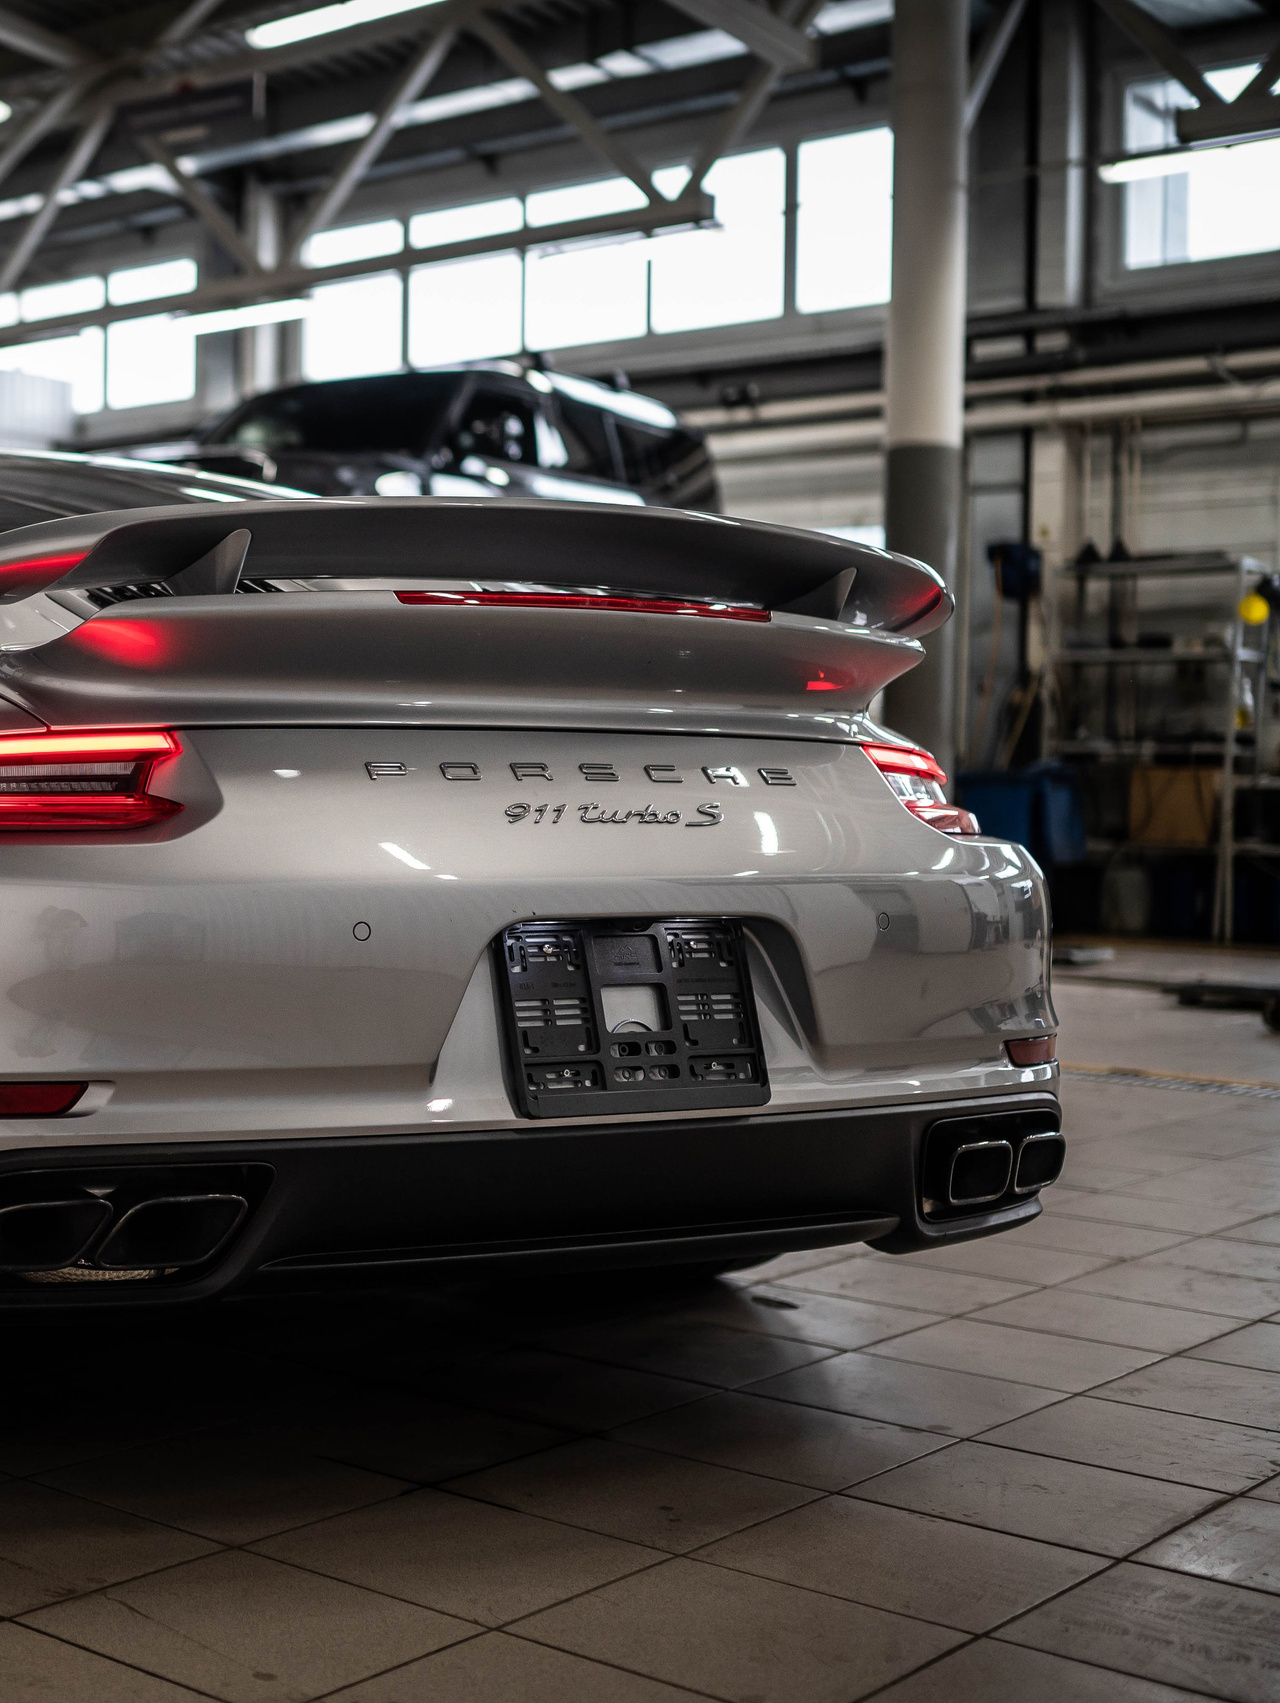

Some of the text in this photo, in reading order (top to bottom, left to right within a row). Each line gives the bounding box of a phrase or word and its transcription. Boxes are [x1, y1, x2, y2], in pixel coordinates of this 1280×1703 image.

[364, 761, 797, 786] PORSCHE
[504, 802, 568, 824] 911
[685, 802, 724, 827] S
